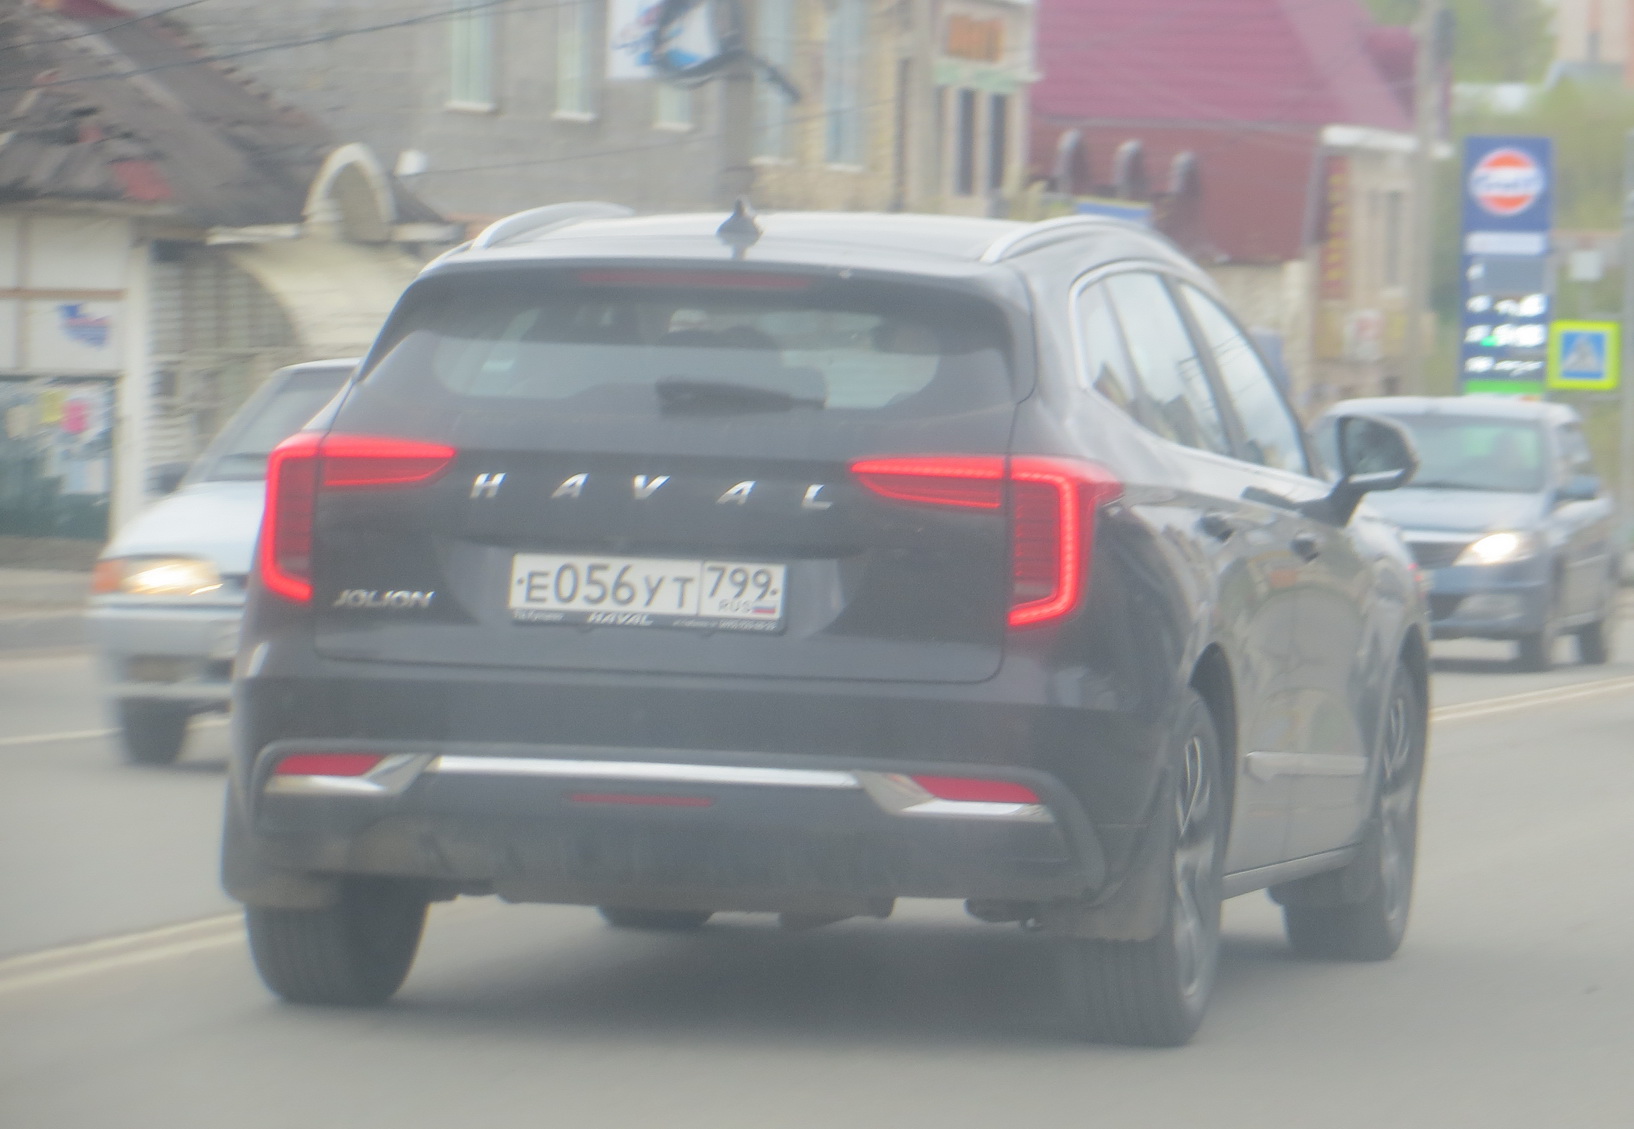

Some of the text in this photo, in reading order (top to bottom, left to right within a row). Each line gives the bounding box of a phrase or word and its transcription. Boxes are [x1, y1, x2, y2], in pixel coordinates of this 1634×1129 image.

[470, 472, 833, 510] HAVAL
[707, 566, 772, 600] 799
[332, 588, 436, 608] JOLION
[717, 600, 754, 613] RUS
[586, 612, 654, 627] HAVAL
